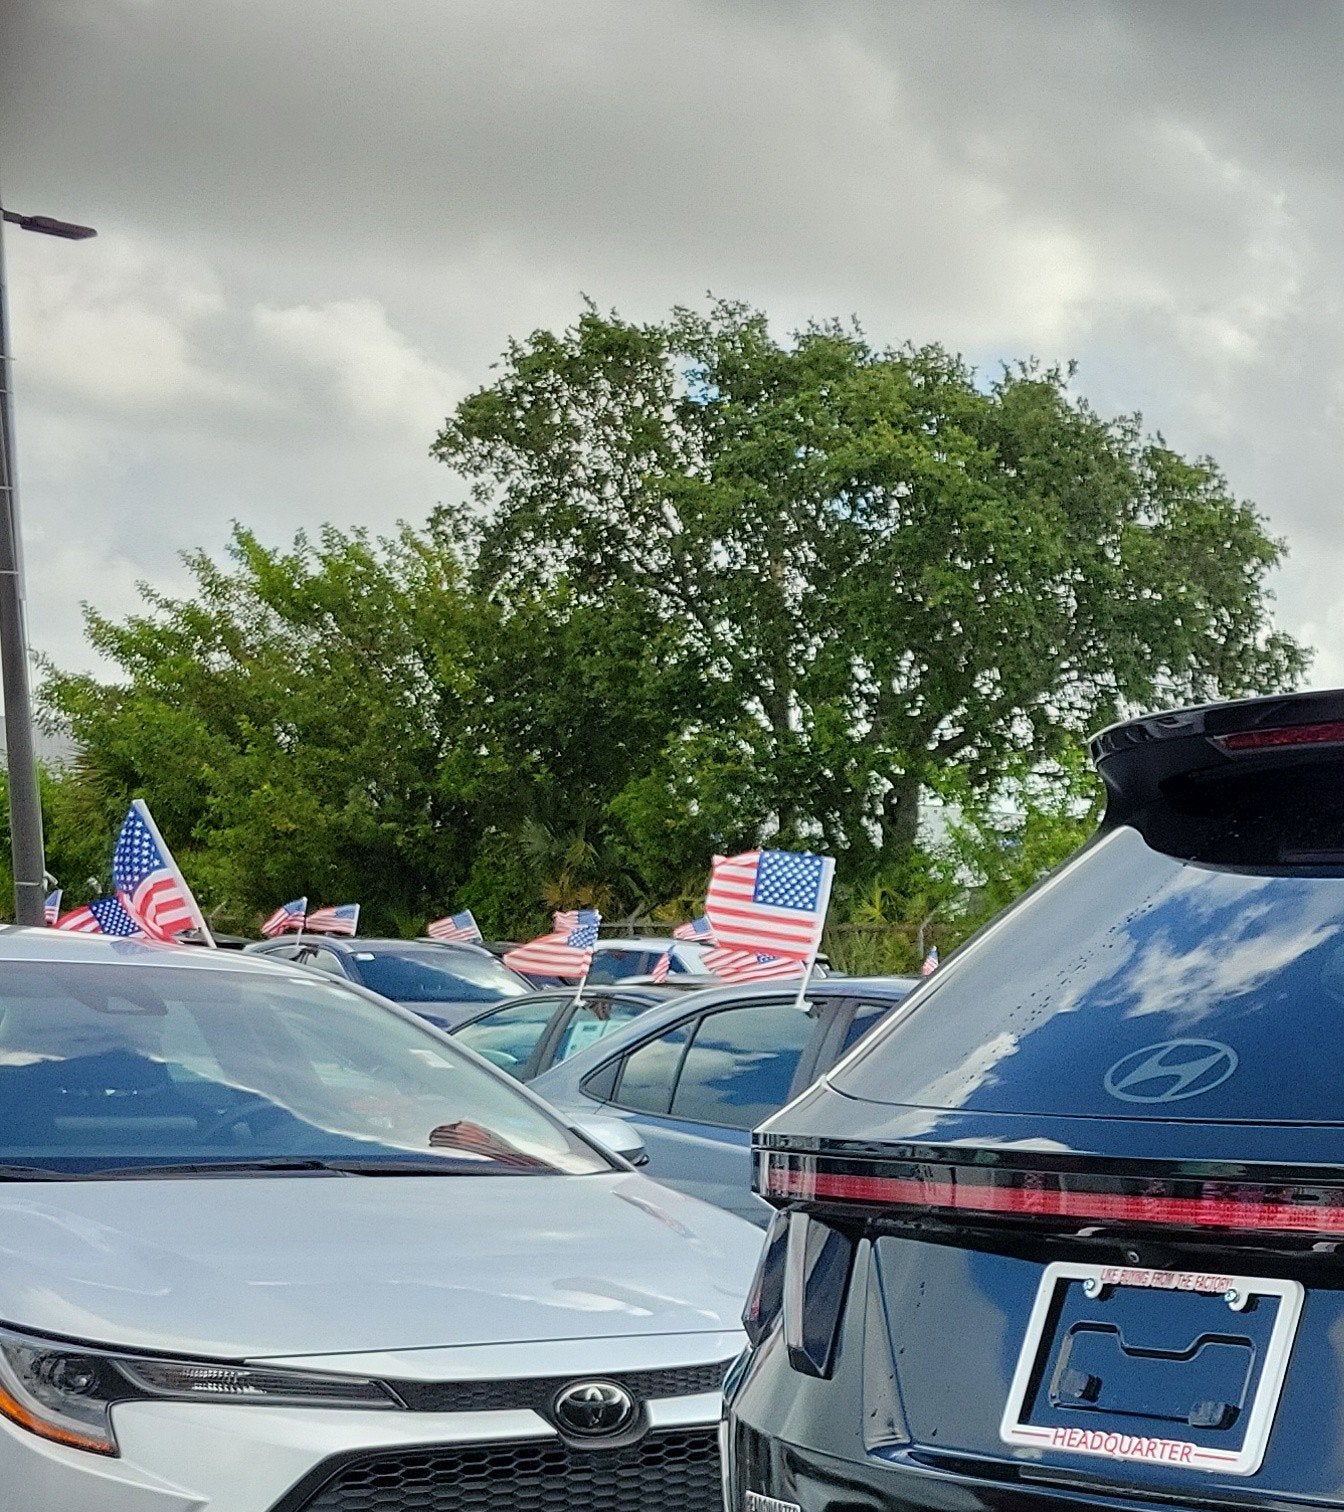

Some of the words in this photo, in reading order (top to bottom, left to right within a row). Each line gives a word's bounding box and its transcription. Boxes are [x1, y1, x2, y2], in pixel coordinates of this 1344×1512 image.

[1152, 1272, 1176, 1288] FROM
[1178, 1274, 1194, 1289] THE
[1051, 1428, 1193, 1463] HEADQUARTER
